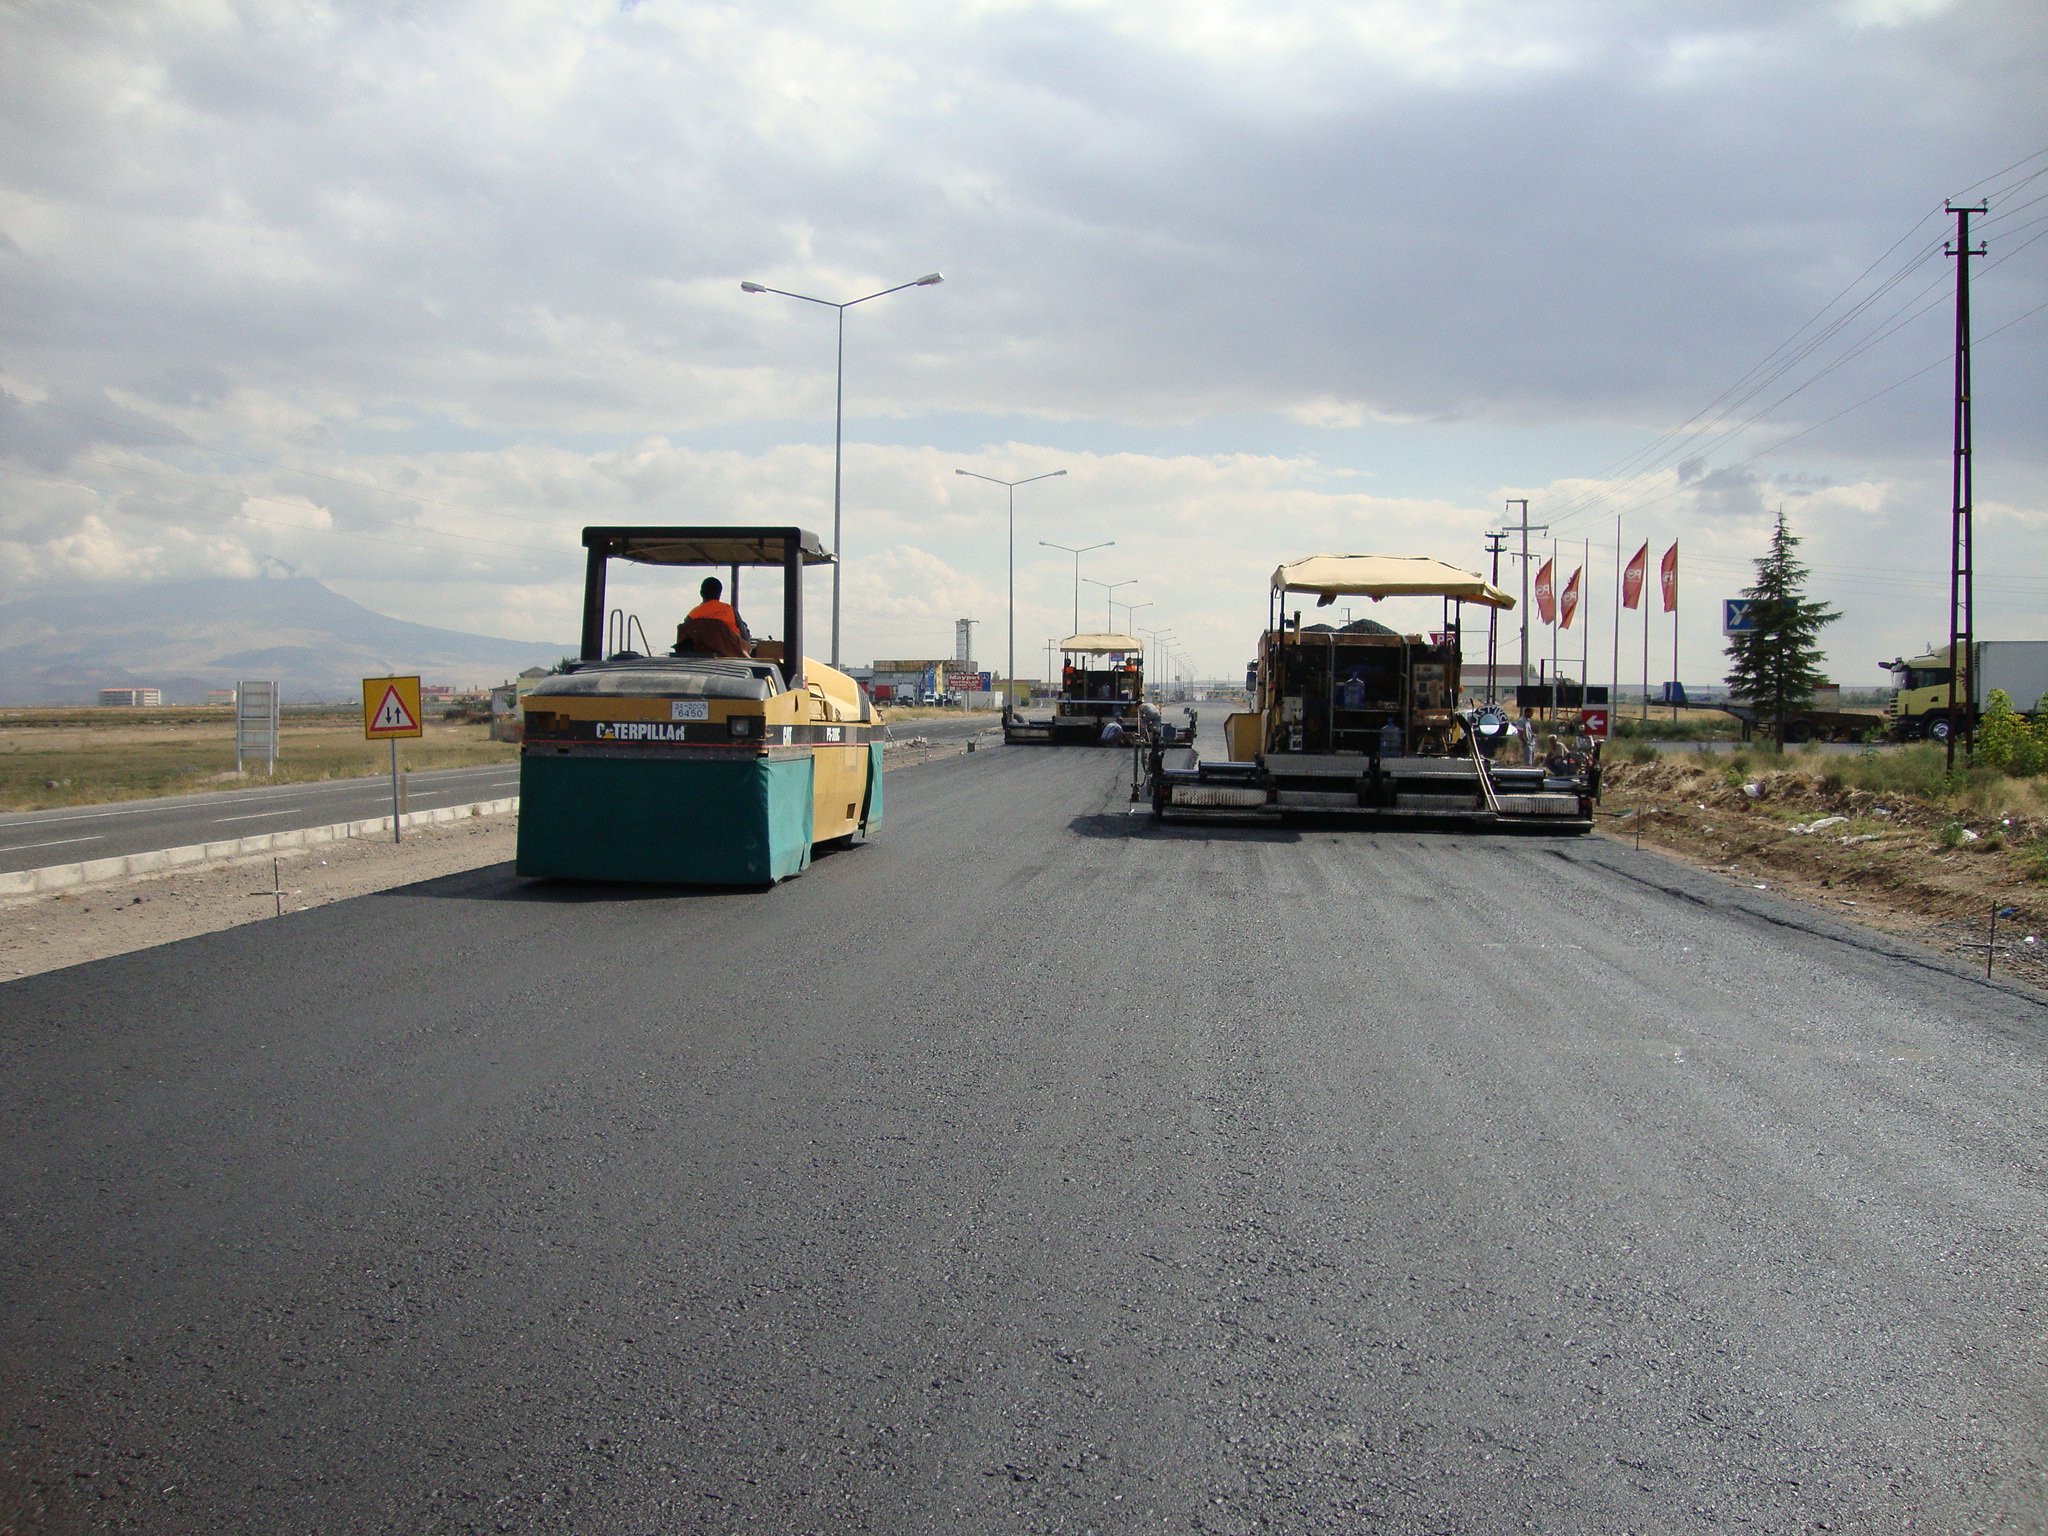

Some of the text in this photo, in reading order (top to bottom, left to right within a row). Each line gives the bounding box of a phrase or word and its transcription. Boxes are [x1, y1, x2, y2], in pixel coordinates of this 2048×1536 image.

[678, 710, 703, 718] 6450
[596, 722, 686, 741] CATERPILLAR
[782, 726, 793, 746] CAT
